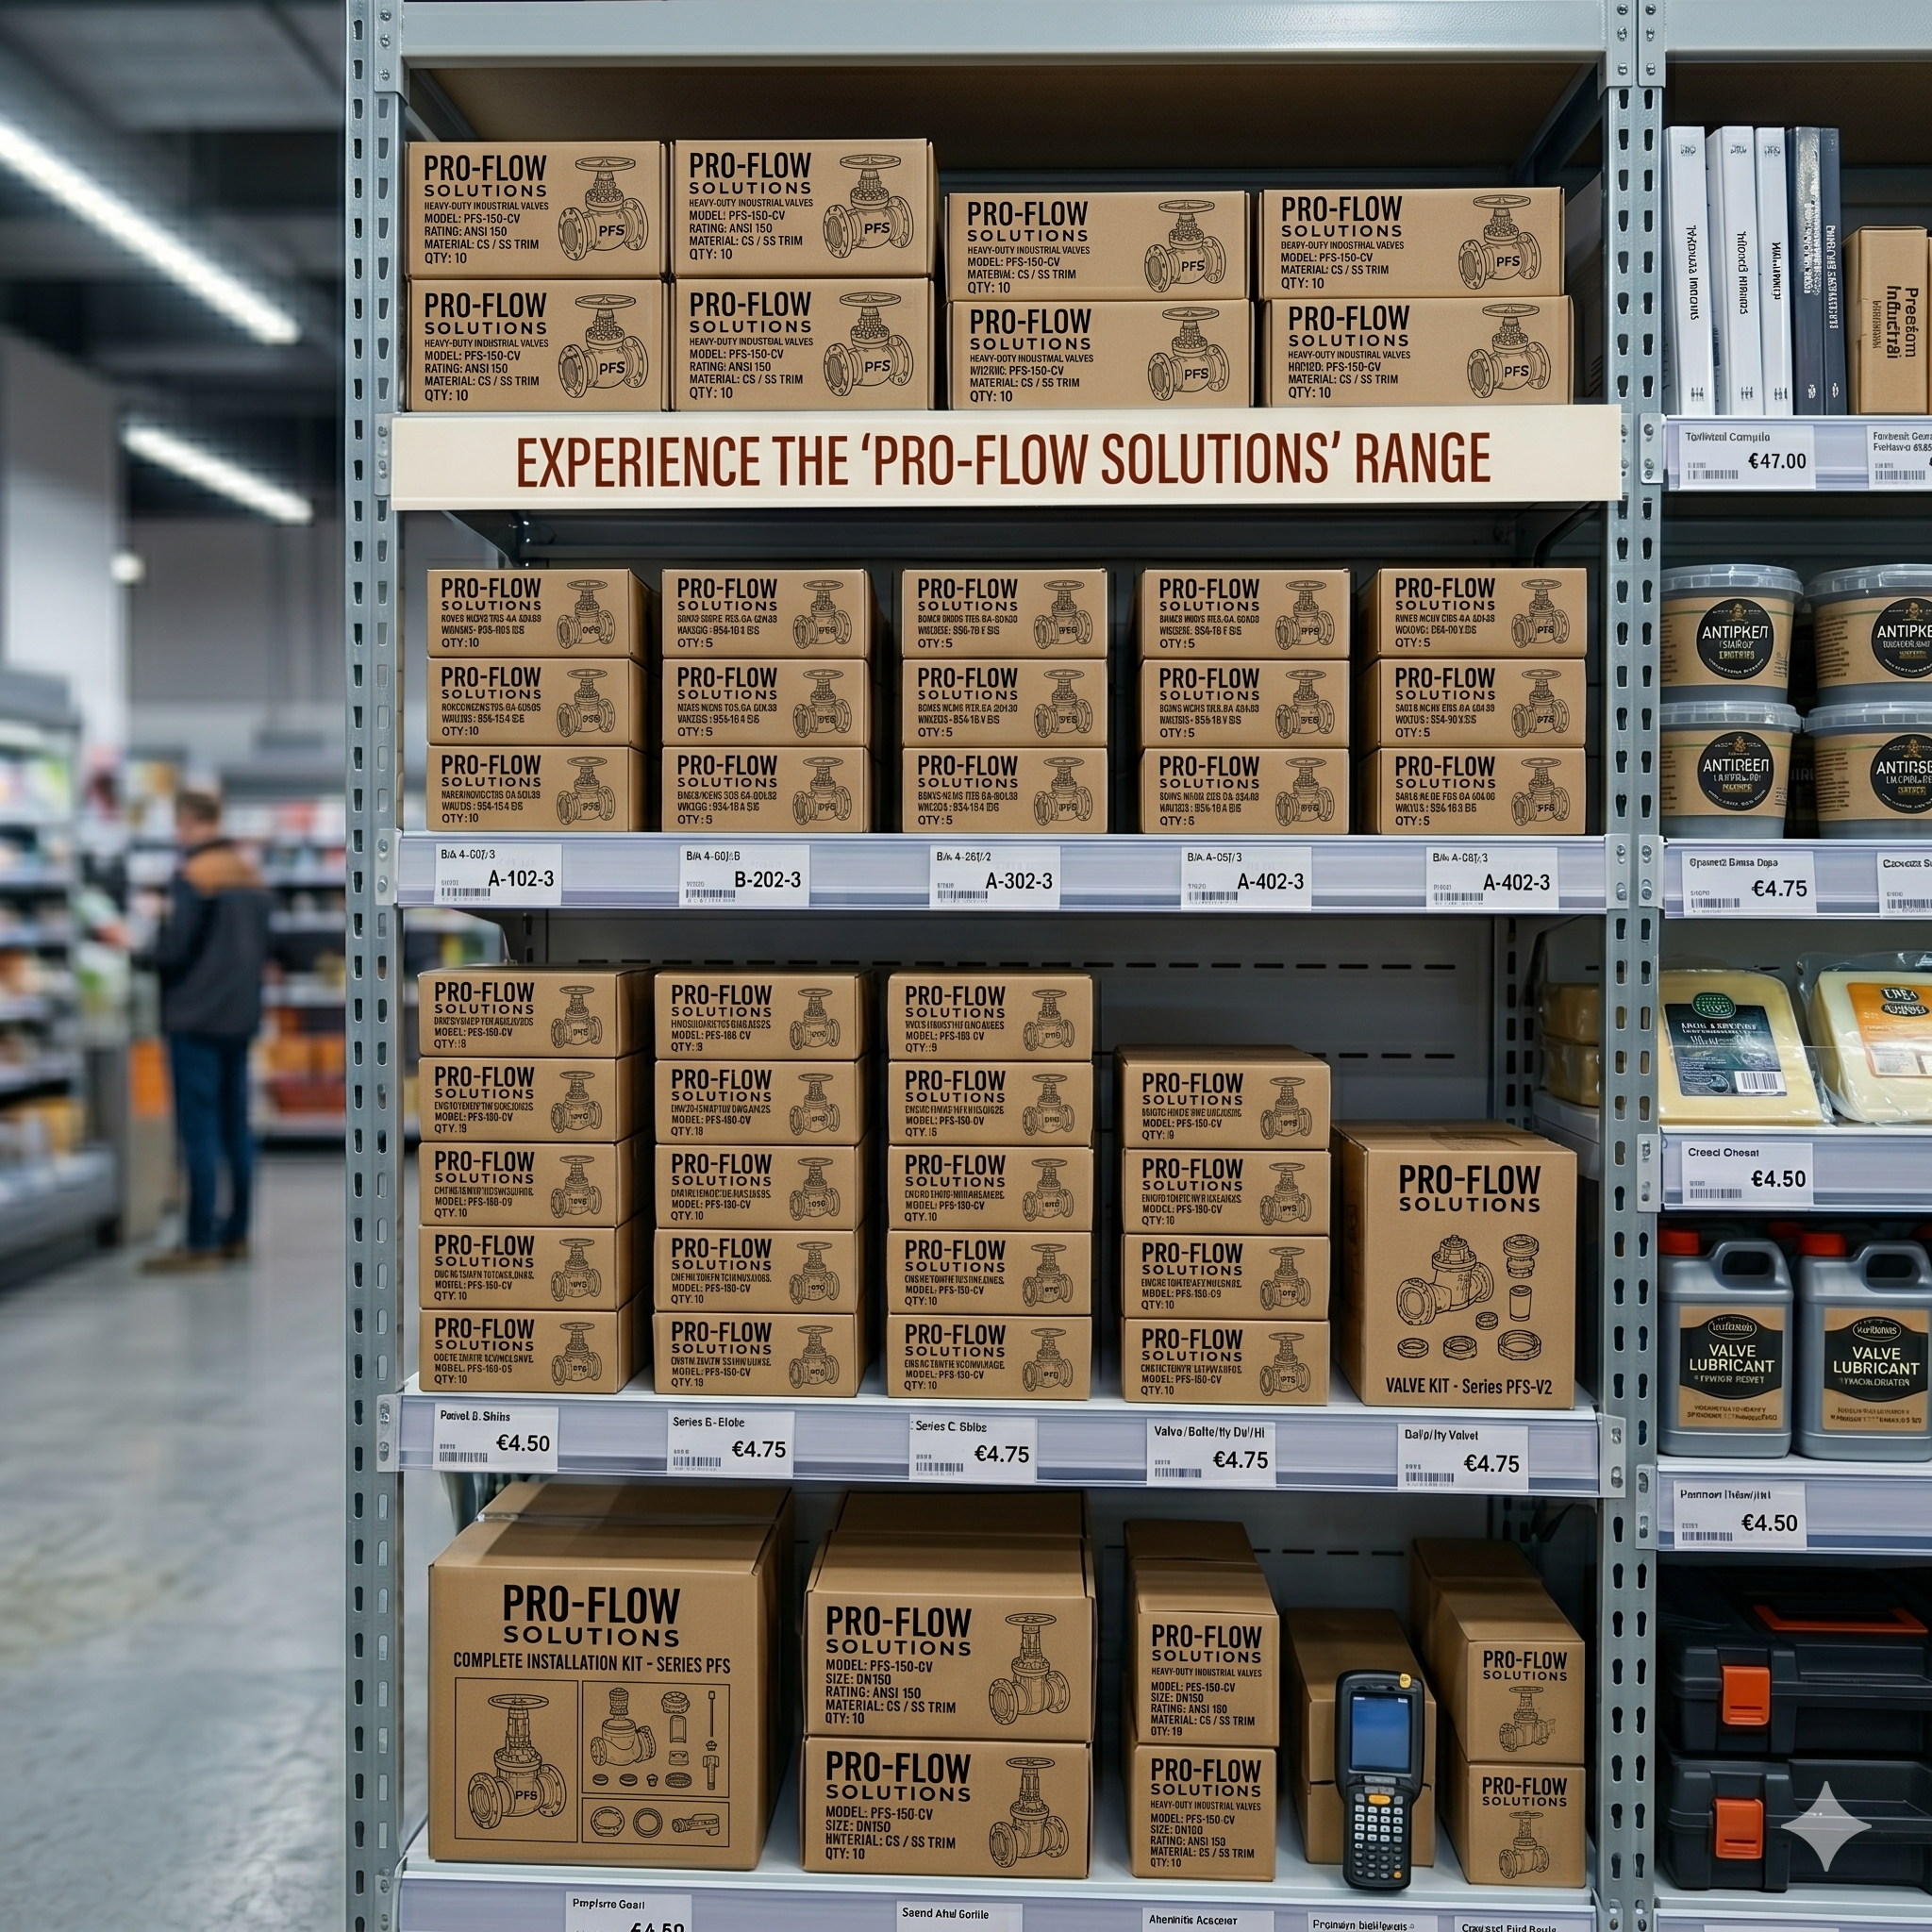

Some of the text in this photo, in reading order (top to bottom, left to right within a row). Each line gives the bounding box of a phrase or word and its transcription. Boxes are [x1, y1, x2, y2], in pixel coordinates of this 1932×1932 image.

[425, 155, 547, 182] PRO-FLOW
[690, 152, 811, 178] PRO-FLOW
[425, 184, 546, 197] SOLUTIONS
[689, 181, 811, 194] SOLUTIONS
[968, 201, 1089, 226] PRO-FLOW
[1282, 195, 1403, 222] PRO-FLOW
[598, 224, 625, 237] PFS
[864, 222, 891, 235] PFS
[967, 229, 1088, 242] SOLUTIONS
[1281, 225, 1402, 238] SOLUTIONS
[425, 252, 467, 265] QTY: 10
[690, 248, 733, 260] QTY: 10
[1496, 255, 1521, 267] PFS
[1181, 259, 1206, 273] PFS
[967, 281, 1010, 294] QTY: 10
[1281, 276, 1324, 290] QTY: 10
[425, 292, 547, 318] PRO-FLOW
[691, 291, 811, 317] PRO-FLOW
[971, 308, 1091, 335] PRO-FLOW
[1289, 305, 1410, 331] PRO-FLOW
[425, 322, 547, 335] SOLUTIONS
[690, 320, 811, 333] SOLUTIONS
[970, 338, 1091, 351] SOLUTIONS
[1289, 334, 1408, 347] SOLUTIONS
[599, 360, 625, 375] PFS
[864, 359, 891, 373] PFS
[1504, 365, 1529, 378] PFS
[425, 389, 469, 403] QTY: 10
[690, 386, 733, 400] QTY: 10
[970, 390, 1013, 403] QTY: 10
[1288, 386, 1331, 399] QTY: 10
[518, 436, 760, 488] EXPERIENCE
[772, 435, 849, 486] THE
[1356, 432, 1491, 483] RANGE
[1748, 452, 1807, 470] €47.00
[441, 577, 541, 598] PRO-FLOW
[918, 578, 1018, 599] PRO-FLOW
[1395, 577, 1496, 598] PRO-FLOW
[441, 600, 541, 611] SOLUTIONS
[918, 601, 1018, 611] SOLUTIONS
[1395, 600, 1495, 611] SOLUTIONS
[488, 869, 554, 887] A-102-3
[735, 871, 801, 888] B-202-3
[985, 872, 1053, 890] A-302-3
[1237, 873, 1304, 890] A-402-3
[1483, 874, 1550, 891] A-402-3
[1751, 879, 1807, 897] €4.75
[435, 981, 535, 1003] PRO-FLOW
[434, 1004, 534, 1015] SOLUTIONS
[1142, 1073, 1244, 1093] PRO-FLOW
[1142, 1094, 1243, 1106] SOLUTIONS
[1400, 1164, 1541, 1195] PRO-FLOW
[1751, 1170, 1806, 1188] €4.50
[1399, 1196, 1541, 1213] SOLUTIONS
[904, 1296, 927, 1307] QTY:
[672, 1321, 773, 1342] PRO-FLOW
[672, 1343, 772, 1355] SOLUTIONS
[1708, 1343, 1756, 1357] VALVE
[1852, 1346, 1901, 1360] VALVE
[1690, 1358, 1775, 1373] LUBRICANT
[1834, 1360, 1921, 1375] LUBRICANT
[1386, 1377, 1425, 1393] VALVE
[1429, 1377, 1450, 1393] KIT
[1462, 1378, 1503, 1394] Series
[1507, 1379, 1553, 1395] PFS-V2
[915, 1420, 945, 1431] Series
[496, 1434, 550, 1452] €4.50
[731, 1441, 786, 1458] €4.75
[974, 1444, 1029, 1463] €4.75
[1212, 1450, 1268, 1469] €4.75
[1463, 1454, 1520, 1473] €4.75
[1740, 1513, 1798, 1532] €4.50
[504, 1584, 681, 1624] PRO-FLOW
[826, 1606, 972, 1638] PRO-FLOW
[504, 1625, 679, 1648] SOLUTIONS
[1152, 1624, 1262, 1649] PRO-FLOW
[825, 1639, 971, 1657] SOLUTIONS
[454, 1652, 523, 1669] COMPLETE
[527, 1653, 617, 1671] INSTALLATION
[622, 1656, 643, 1672] KIT
[657, 1656, 702, 1674] SERIES
[707, 1657, 731, 1674] PFS
[1152, 1649, 1261, 1664] SOLUTIONS
[1483, 1650, 1568, 1670] PRO-FLOW
[825, 1658, 933, 1673] MODEL: PFS-150-CV
[825, 1673, 854, 1685] SIZE:
[1483, 1670, 1568, 1682] SOLUTIONS
[825, 1685, 922, 1699] RATING: ANSI 150
[825, 1712, 865, 1724] QTY: 10
[826, 1751, 972, 1784] PRO-FLOW
[826, 1784, 971, 1803] SOLUTIONS
[1482, 1776, 1568, 1796] PRO-FLOW
[515, 1790, 538, 1801] PFS
[1482, 1796, 1567, 1807] SOLUTIONS
[825, 1819, 891, 1833] SIZE: DN150
